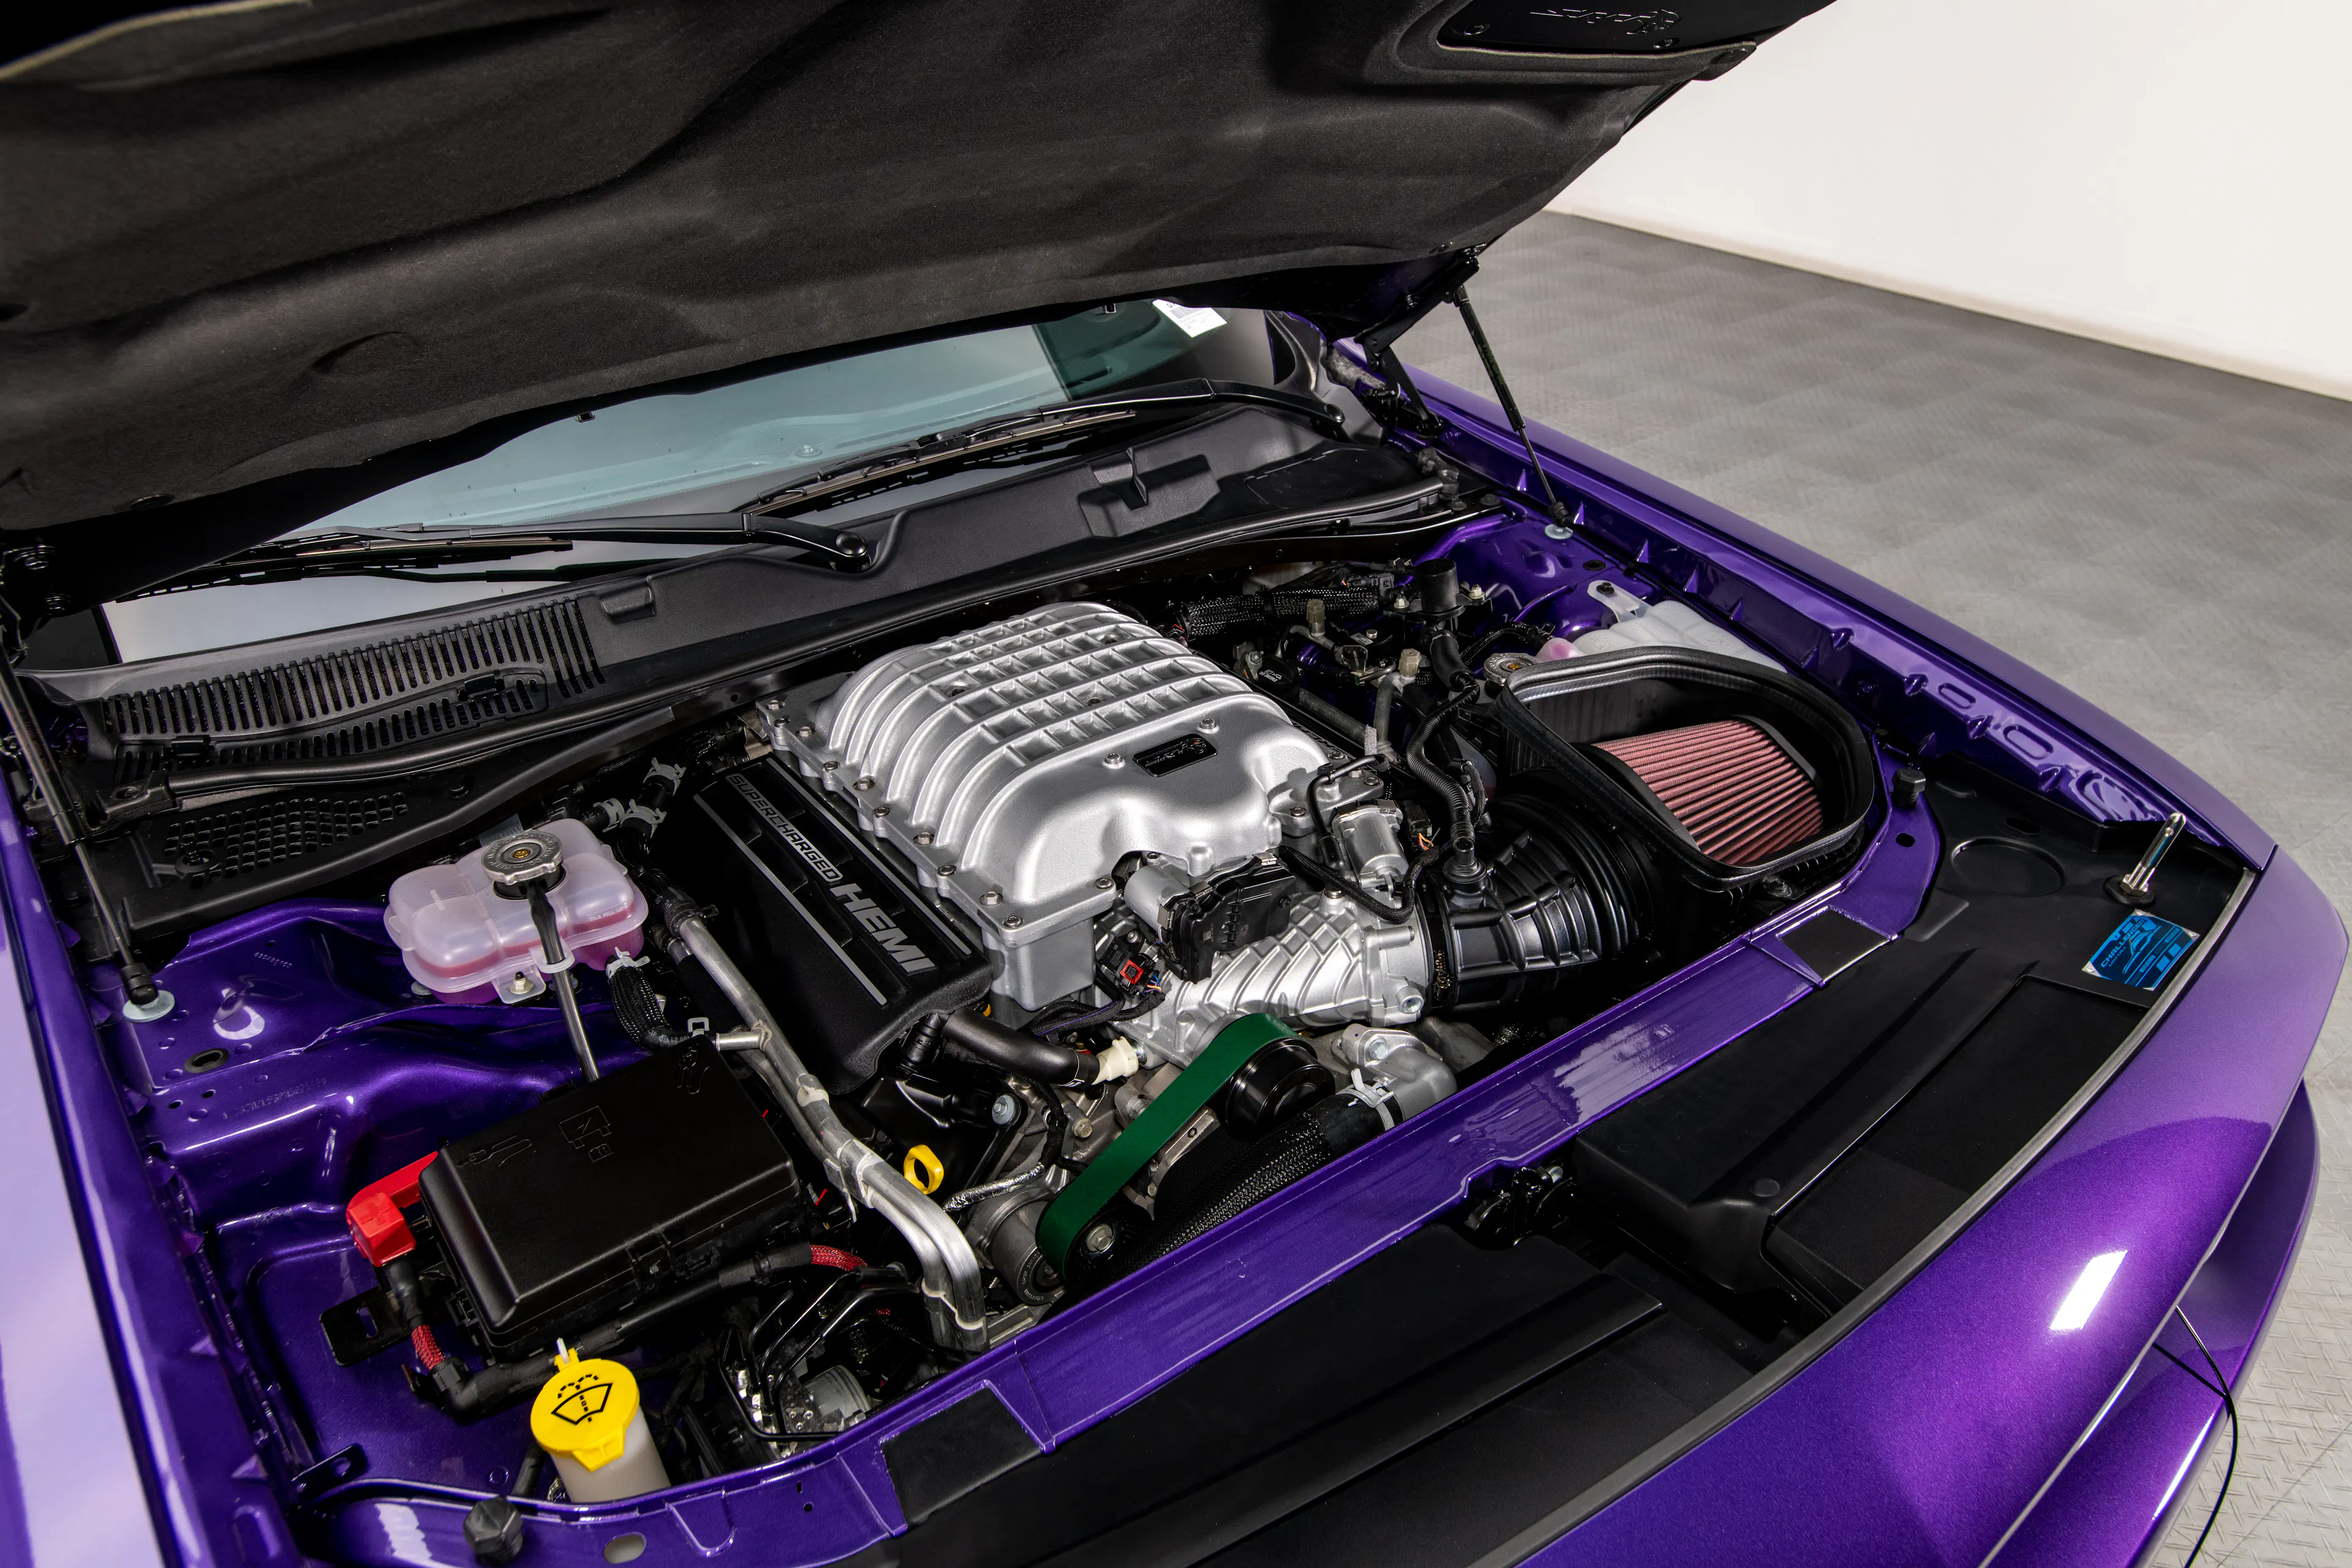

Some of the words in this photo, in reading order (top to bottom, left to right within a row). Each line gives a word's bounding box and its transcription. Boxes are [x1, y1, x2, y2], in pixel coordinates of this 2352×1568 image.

[728, 774, 841, 881] SUPERCHARGED
[830, 884, 937, 974] HEMI
[2100, 918, 2147, 968] CHALLENGER
[2108, 954, 2119, 967] LAST
